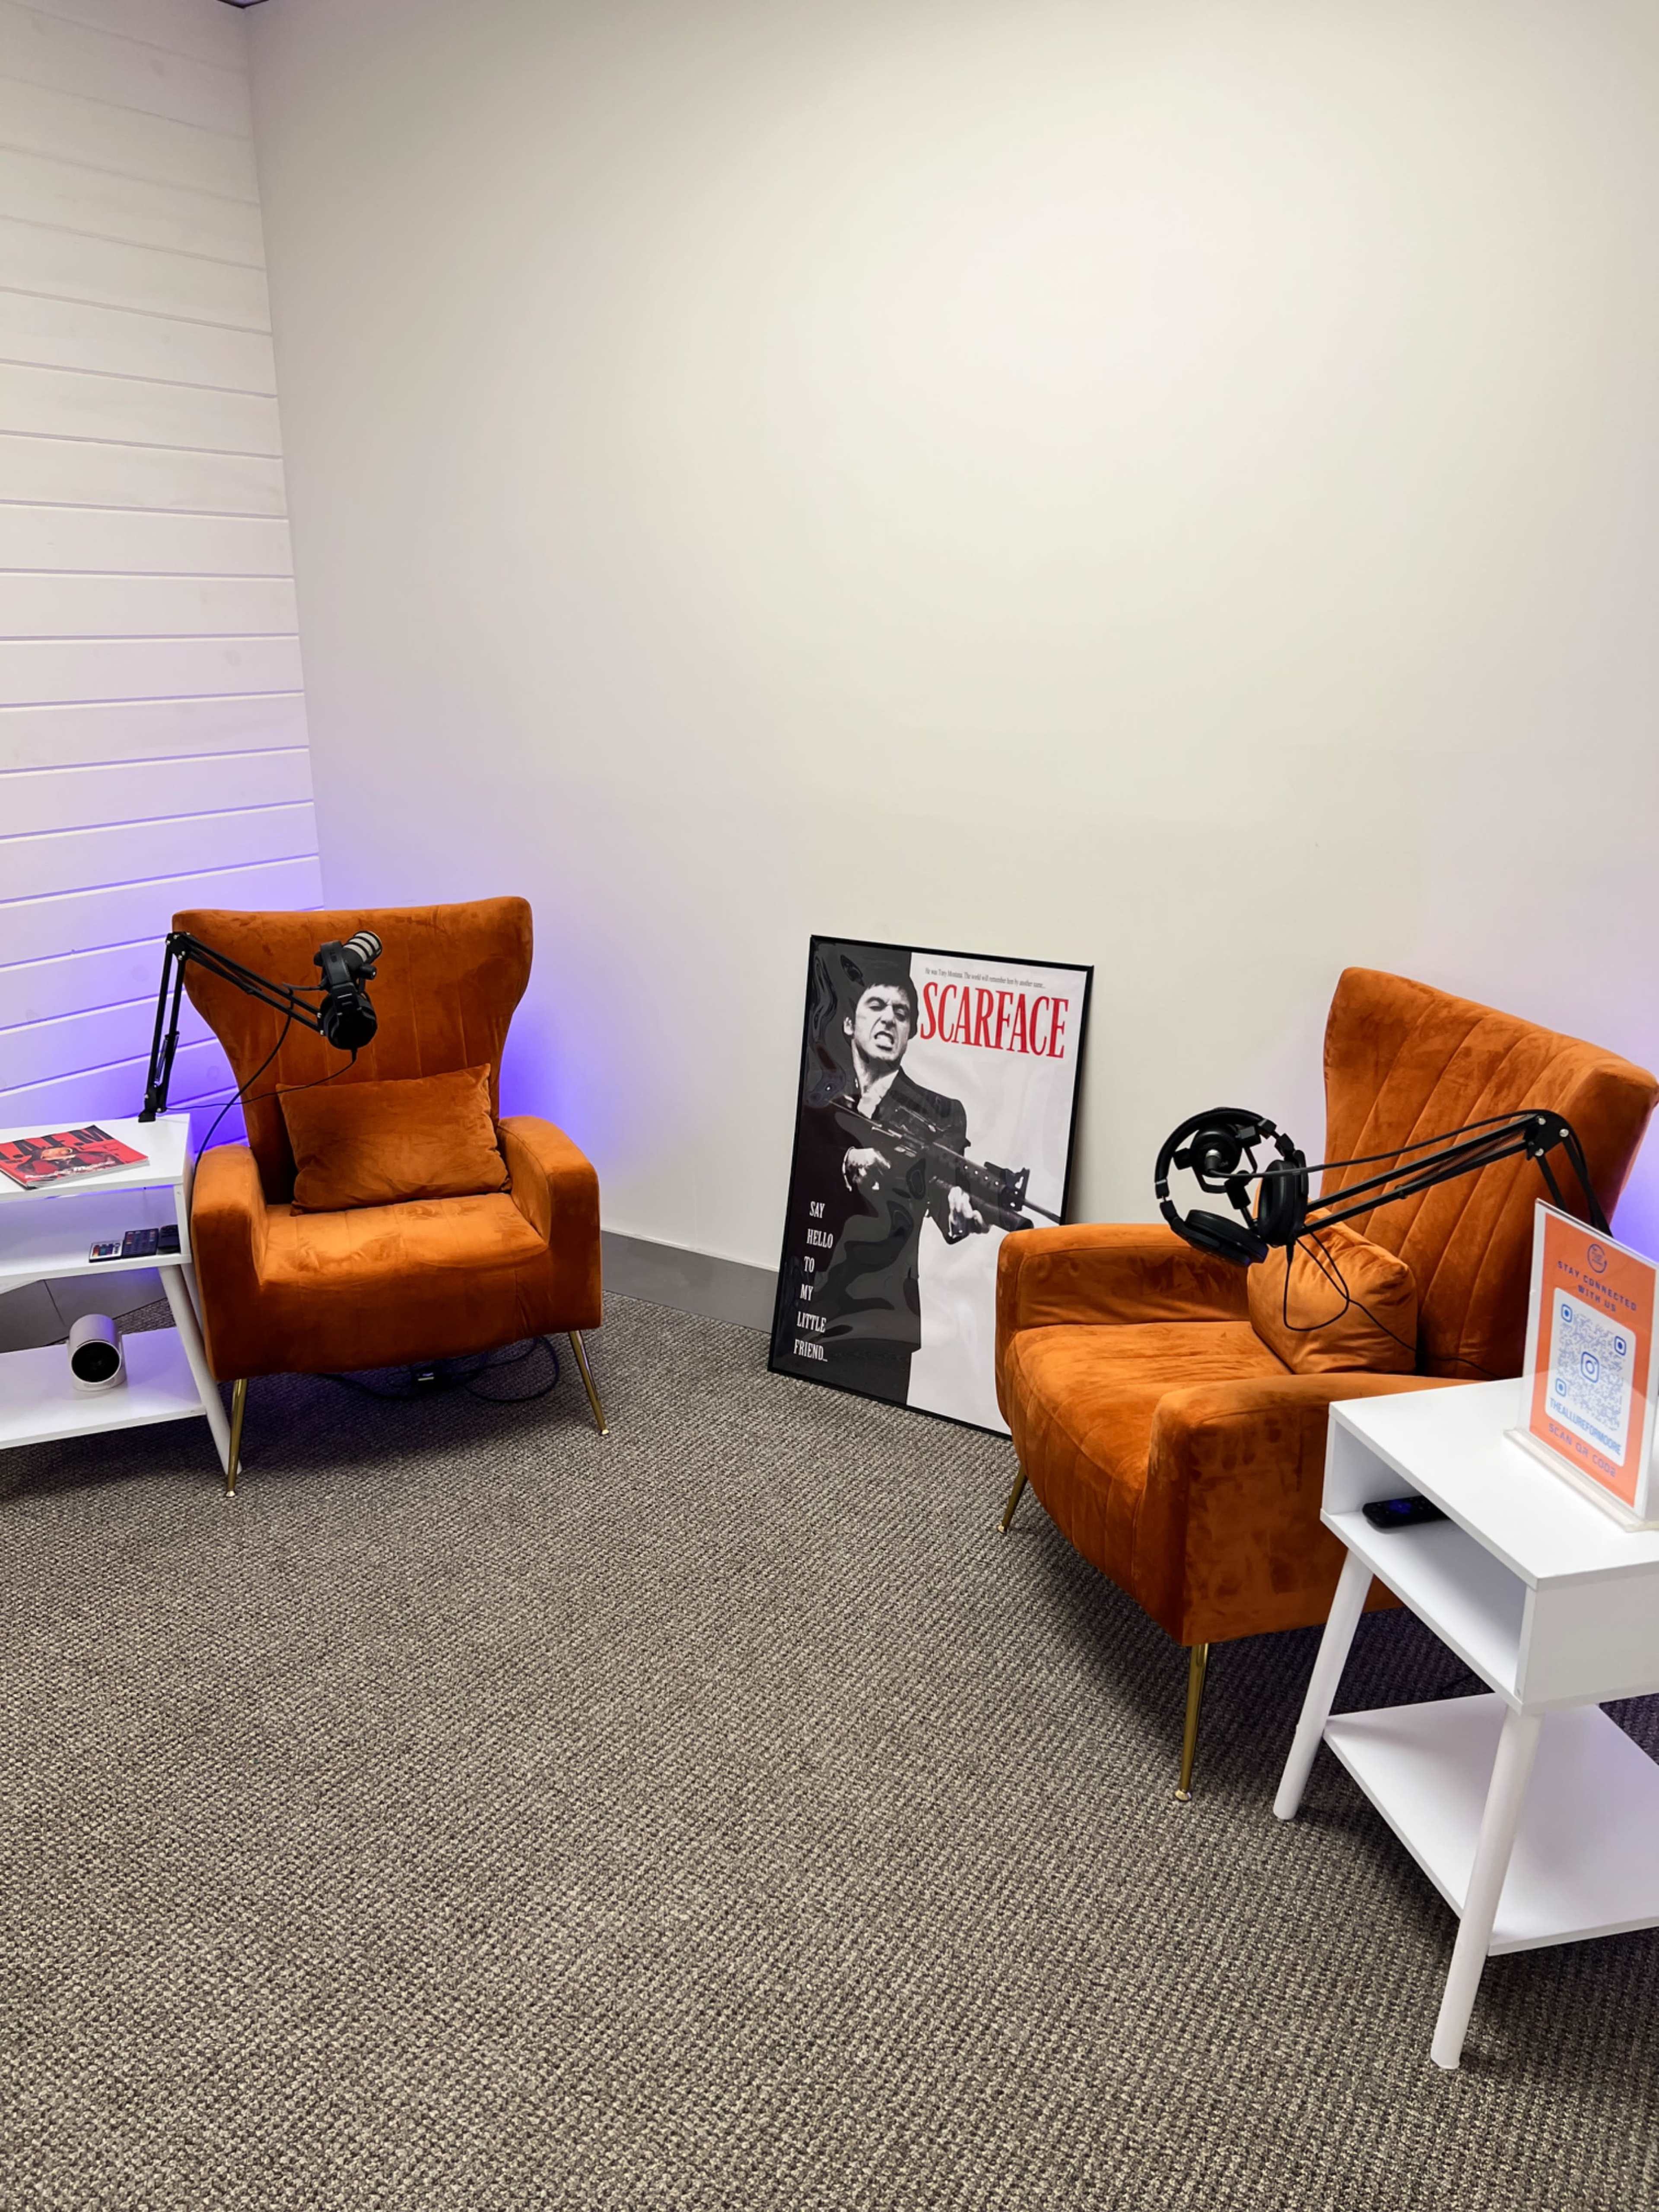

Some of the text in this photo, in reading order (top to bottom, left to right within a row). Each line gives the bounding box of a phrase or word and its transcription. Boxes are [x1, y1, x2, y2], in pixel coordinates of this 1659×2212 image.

[920, 982, 1069, 1058] SCARFACE
[810, 1201, 825, 1218] SAY
[807, 1229, 833, 1249] HELLO
[804, 1256, 815, 1273] TO
[800, 1284, 814, 1301] MY
[1557, 1261, 1637, 1311] STAY CONNECTED
[1578, 1285, 1616, 1312] WITH US
[797, 1311, 827, 1333] LITTLE
[1548, 1423, 1572, 1445] SCAN
[1576, 1443, 1589, 1457] QR
